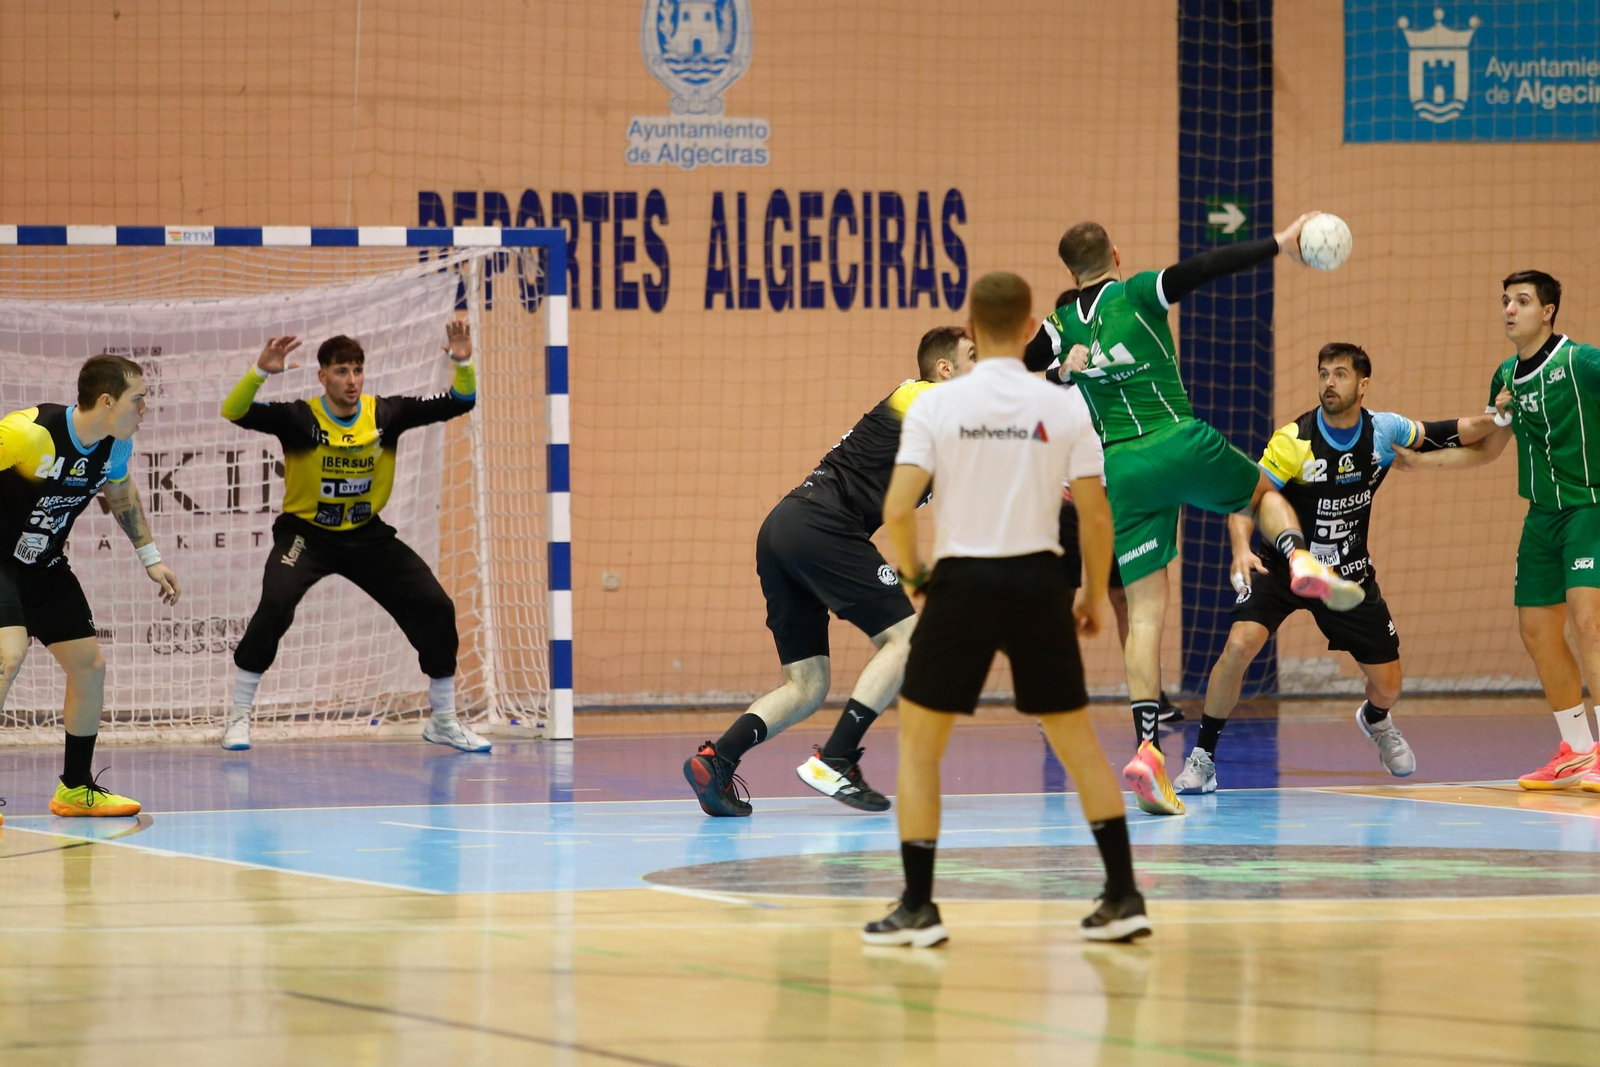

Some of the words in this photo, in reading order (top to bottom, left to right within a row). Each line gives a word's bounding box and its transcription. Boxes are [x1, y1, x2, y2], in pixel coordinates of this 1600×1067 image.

[1485, 56, 1600, 83] Ayuntamie
[1485, 83, 1510, 104] de
[629, 119, 768, 142] Ayuntamiento
[627, 147, 651, 164] de
[657, 143, 768, 169] Algeciras
[183, 231, 213, 242] RTM
[705, 188, 969, 313] ALGECIRAS
[959, 424, 1029, 441] helvetia
[34, 454, 66, 481] 24
[322, 456, 375, 468] IBERSUR
[1302, 458, 1328, 483] 22
[1317, 489, 1371, 511] IBERSUR
[17, 543, 41, 562] UBAG
